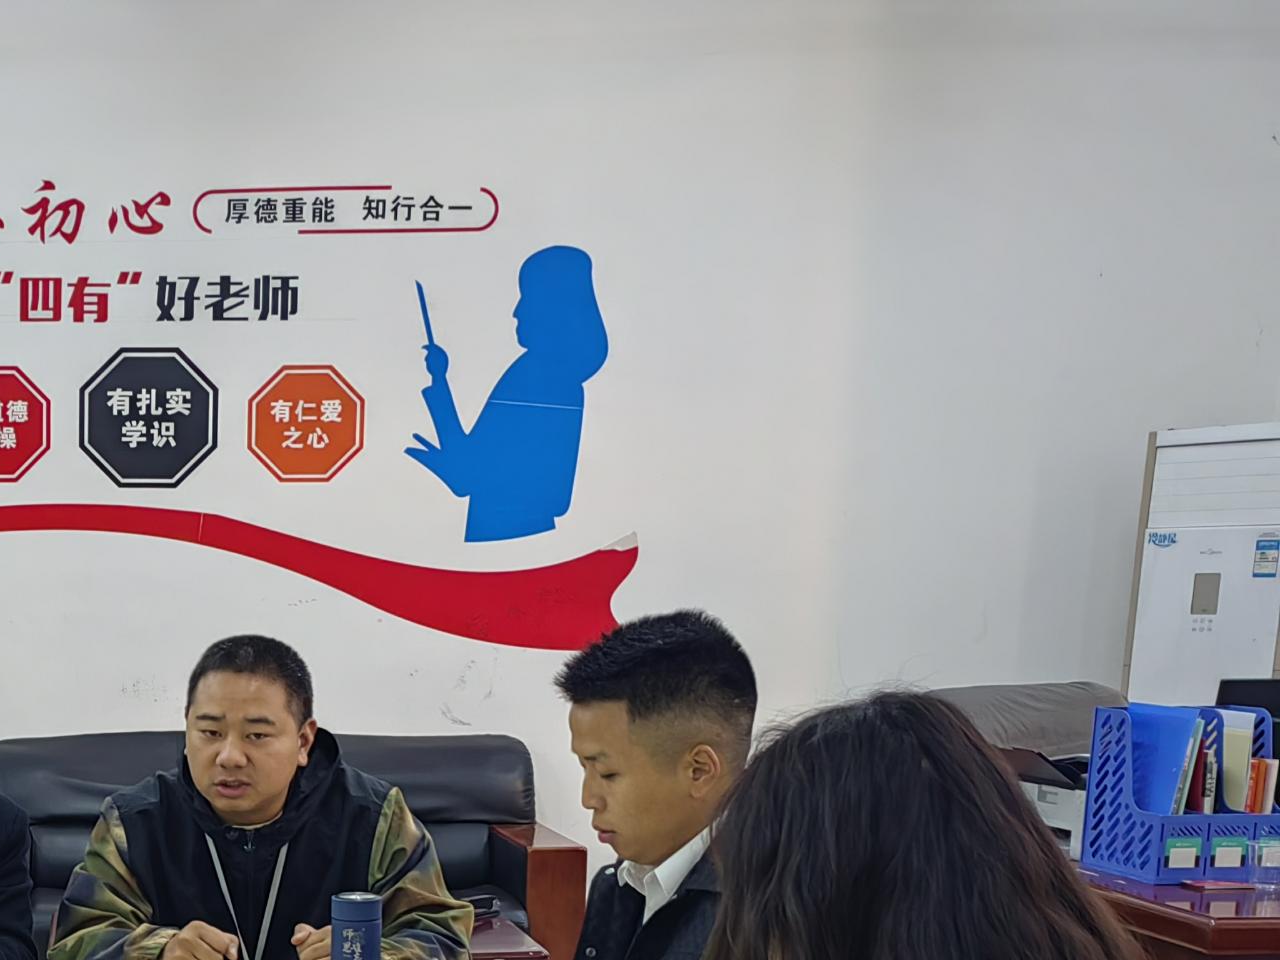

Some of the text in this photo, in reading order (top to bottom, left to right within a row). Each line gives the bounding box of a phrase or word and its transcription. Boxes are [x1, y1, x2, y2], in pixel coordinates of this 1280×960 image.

[223, 195, 473, 225] 厚德重能 知行合一
[106, 387, 192, 416] 有扎实
[270, 399, 343, 424] 有仁爱
[120, 420, 177, 448] 学识
[281, 426, 330, 449] 之心
